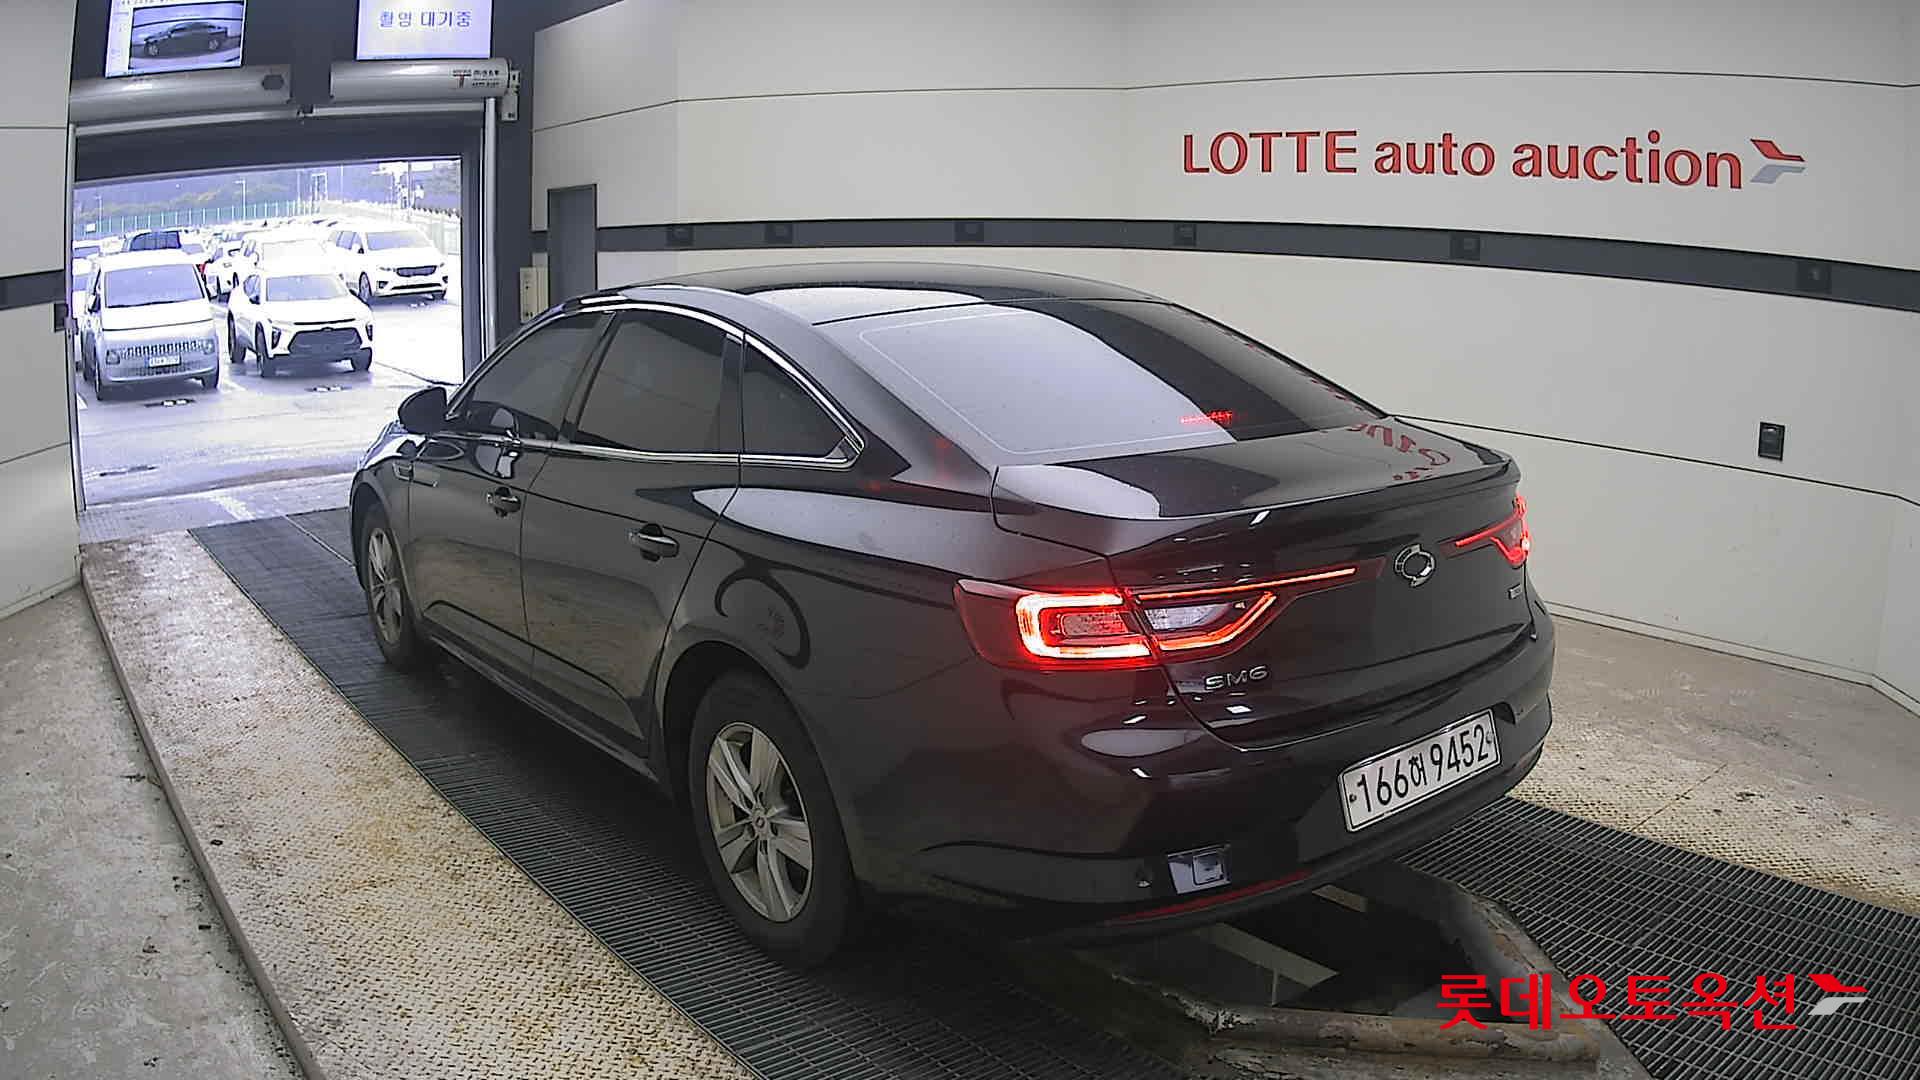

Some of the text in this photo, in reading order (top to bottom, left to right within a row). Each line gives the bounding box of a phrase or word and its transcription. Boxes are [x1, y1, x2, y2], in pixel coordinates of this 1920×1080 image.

[420, 10, 472, 28] 대기중
[1183, 129, 1743, 190] LOTTE auto auction
[1205, 665, 1268, 690] SM6
